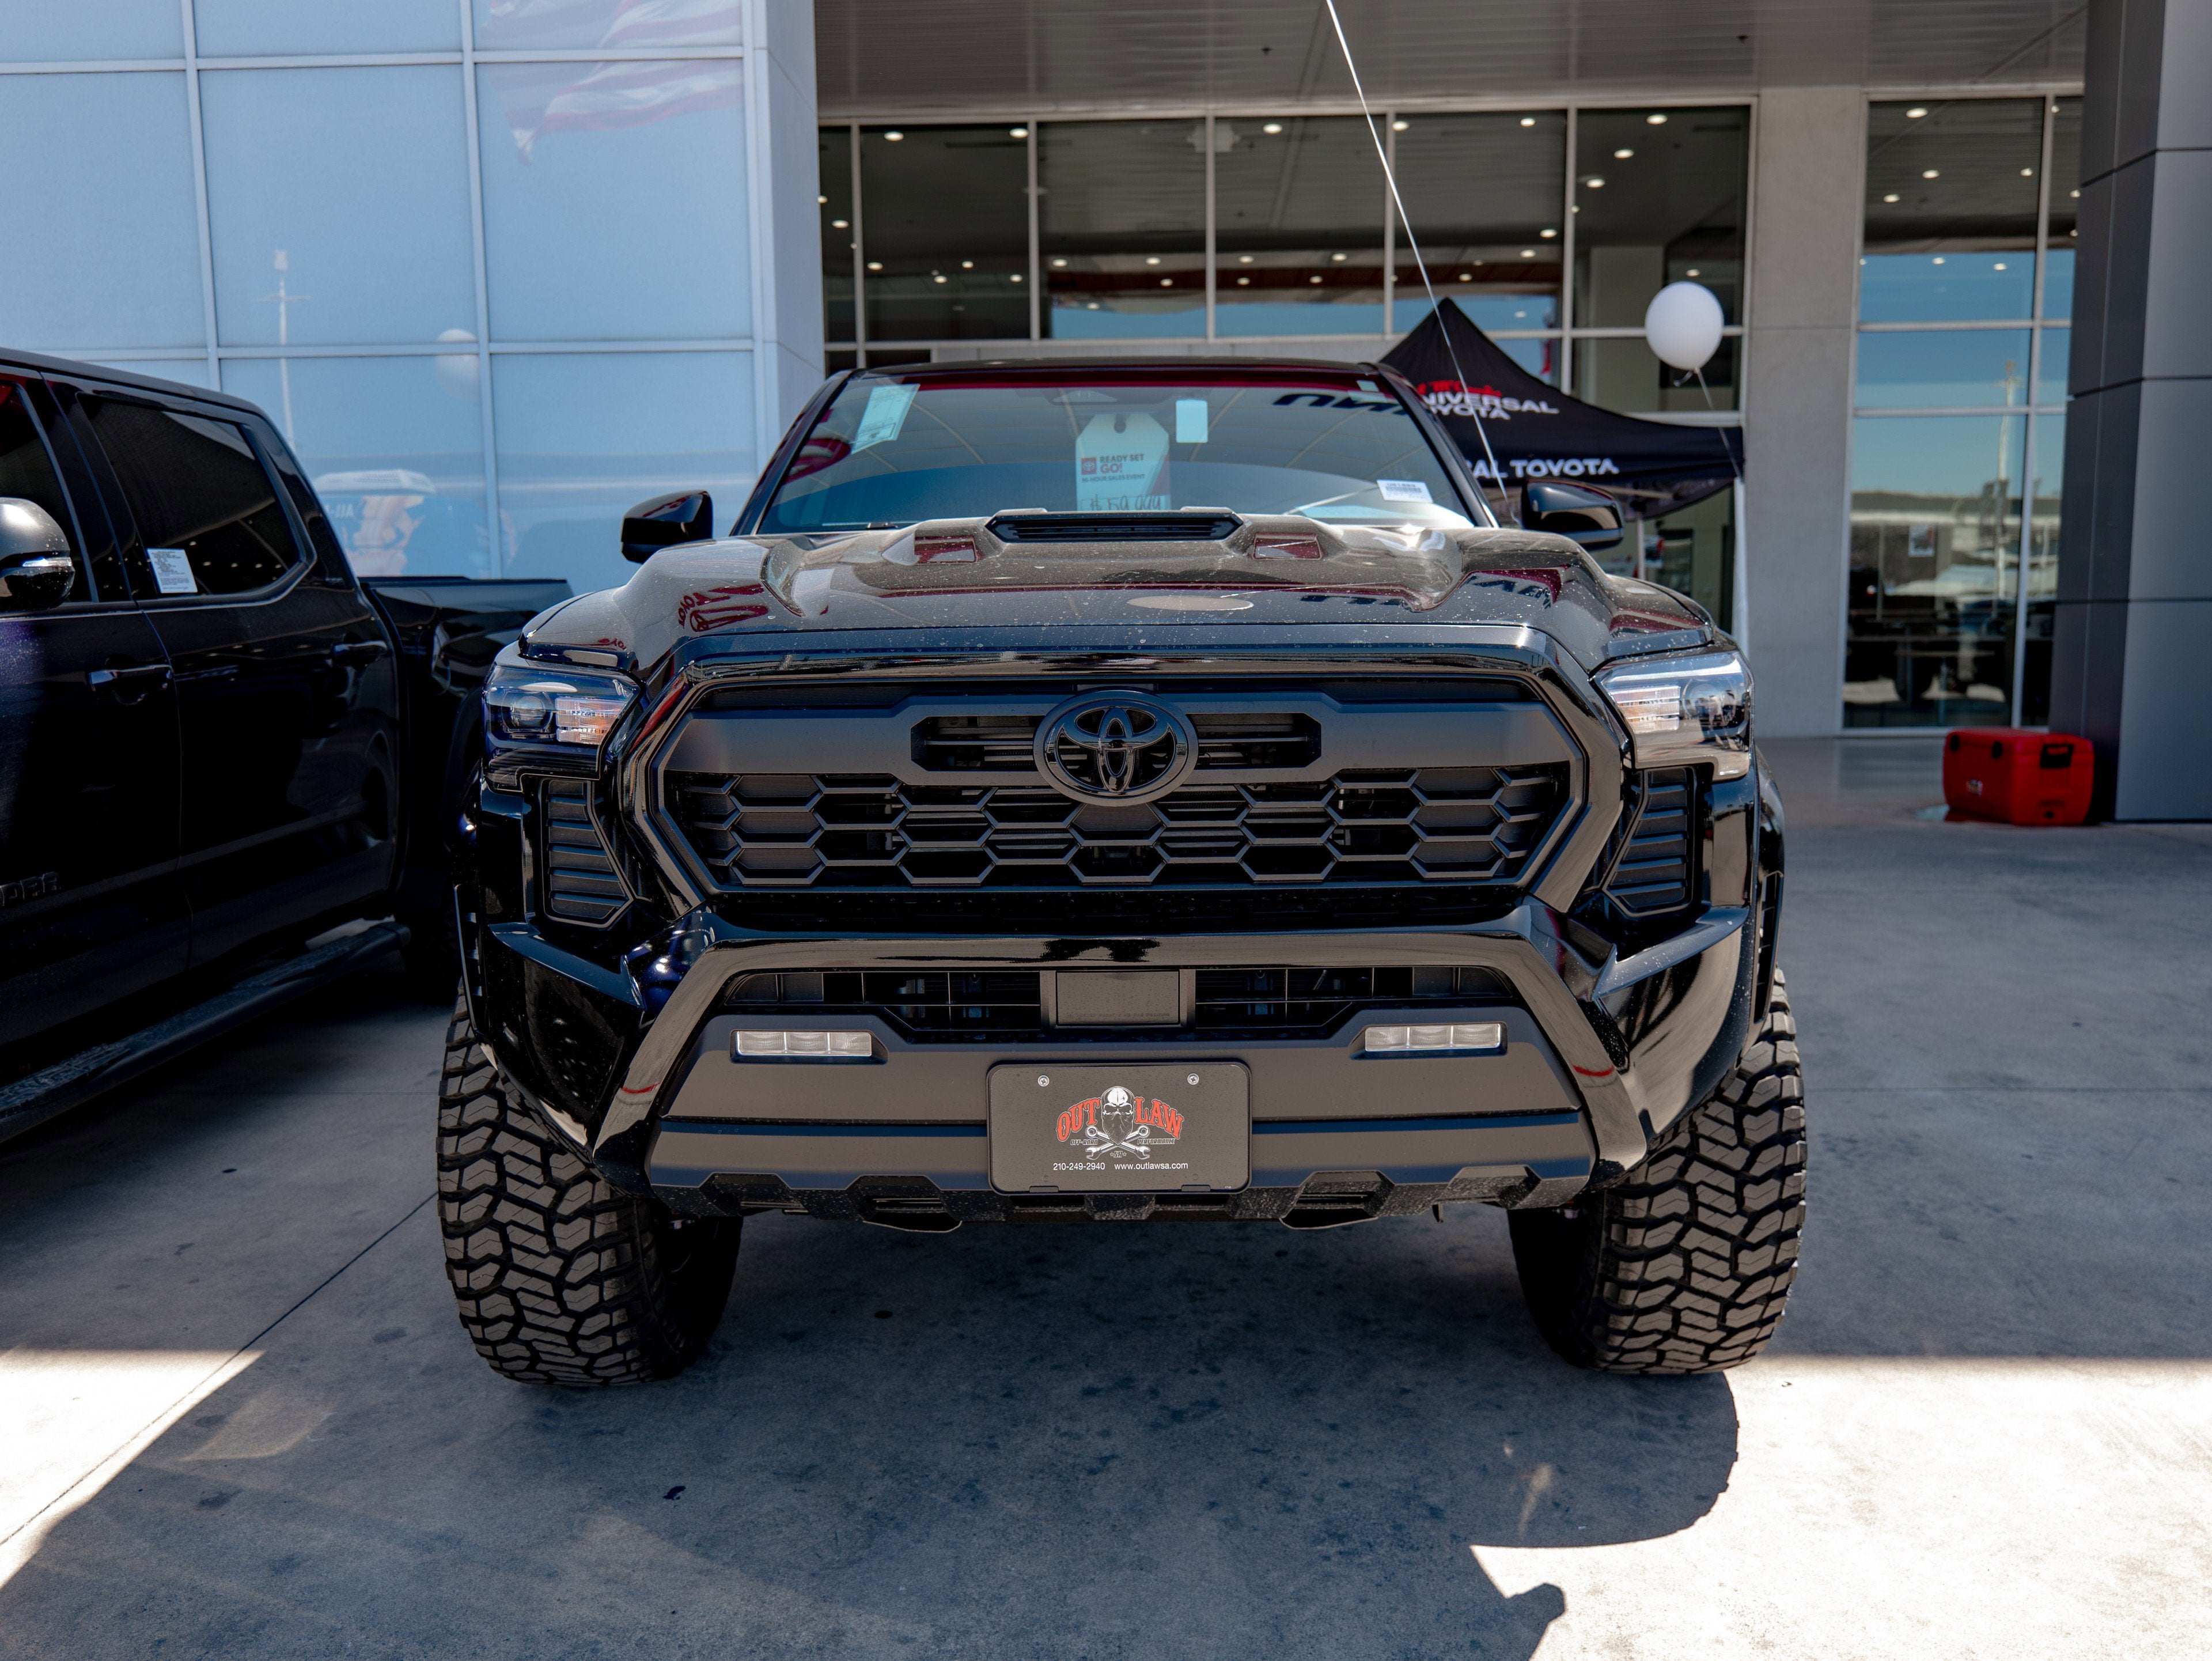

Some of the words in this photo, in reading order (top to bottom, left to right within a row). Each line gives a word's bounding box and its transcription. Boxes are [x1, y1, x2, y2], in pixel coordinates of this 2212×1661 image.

[1422, 391, 1560, 414] NIVERSAL
[1099, 455, 1127, 463] READY
[1129, 453, 1145, 461] SET
[1100, 463, 1123, 474] GO!
[1509, 458, 1620, 478] TOYOTA
[1056, 1098, 1101, 1142] OUT
[1134, 1097, 1184, 1139] LAW
[1053, 1162, 1105, 1171] 210-249-2940
[1114, 1161, 1188, 1170] www.outlawsa.com
